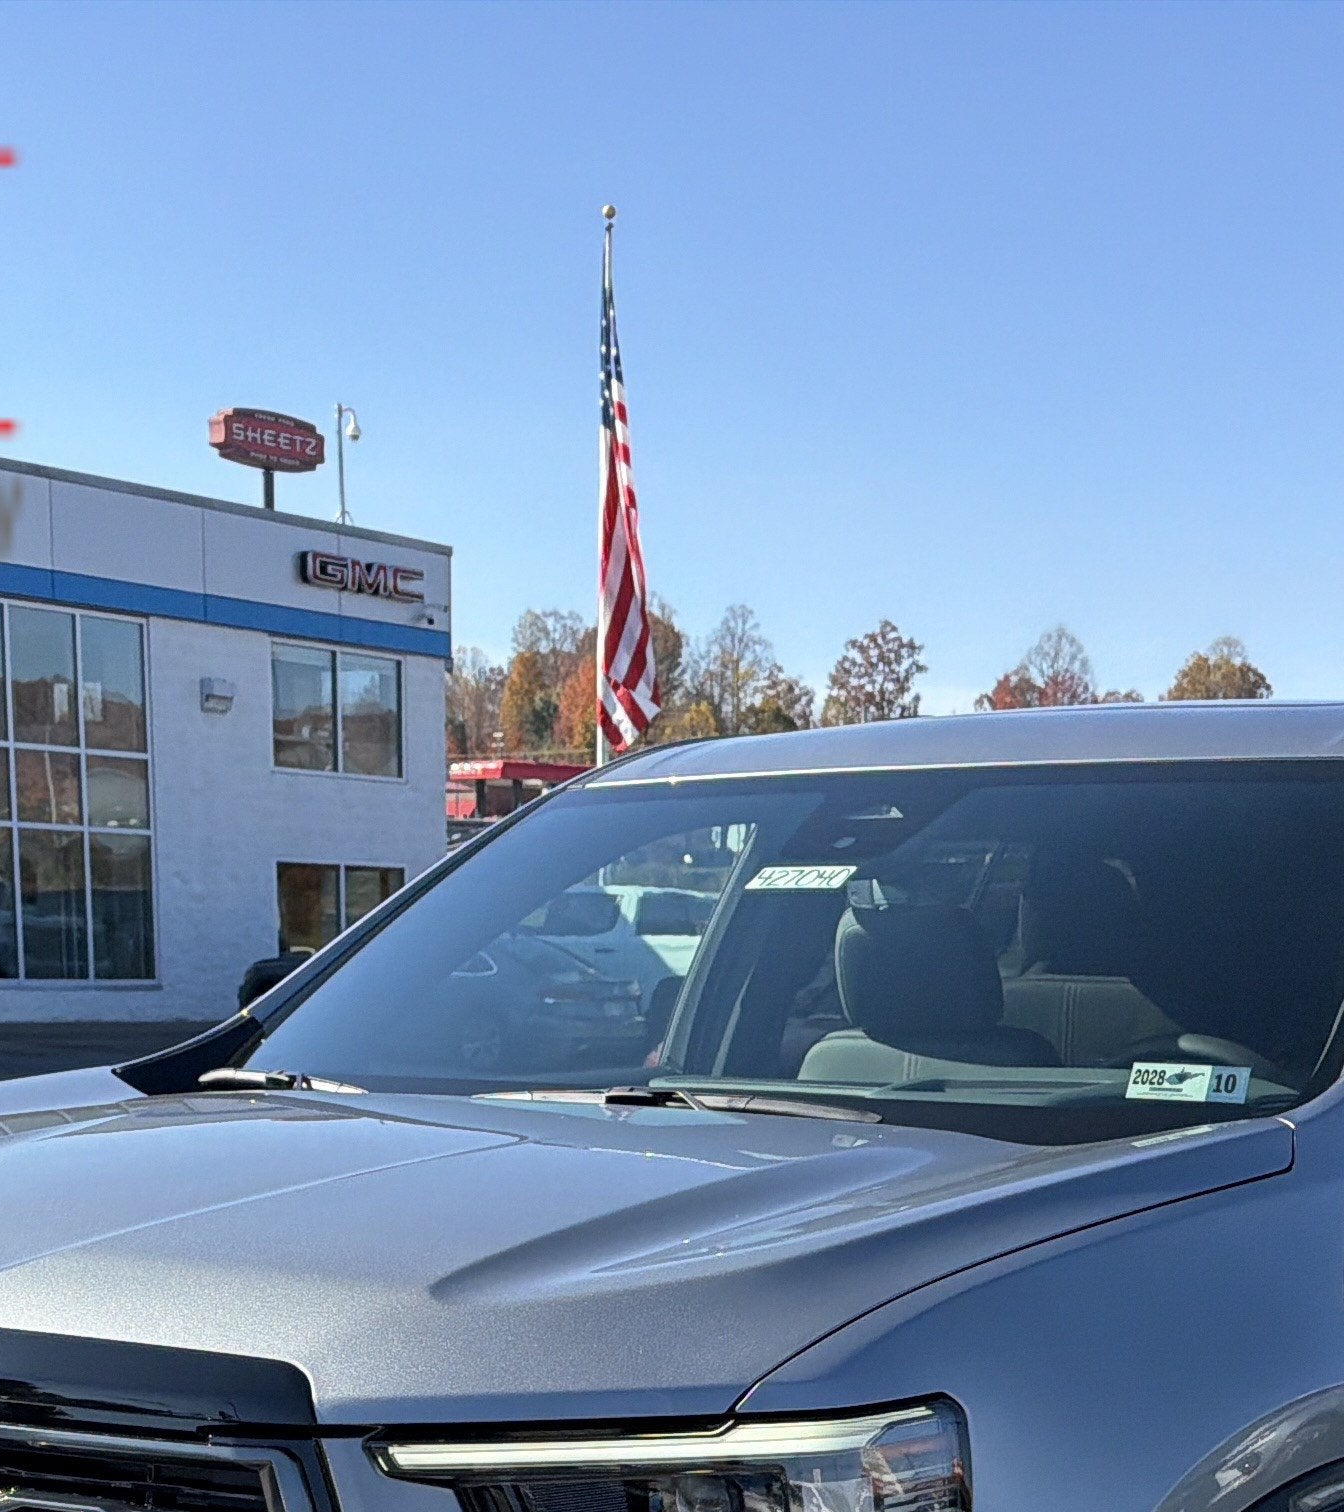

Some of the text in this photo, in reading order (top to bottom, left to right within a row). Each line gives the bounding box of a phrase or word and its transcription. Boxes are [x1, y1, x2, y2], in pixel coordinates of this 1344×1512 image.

[231, 422, 318, 456] SHEETZ
[304, 550, 425, 603] GMC
[1132, 1068, 1167, 1086] 2028
[1212, 1073, 1238, 1094] 10
